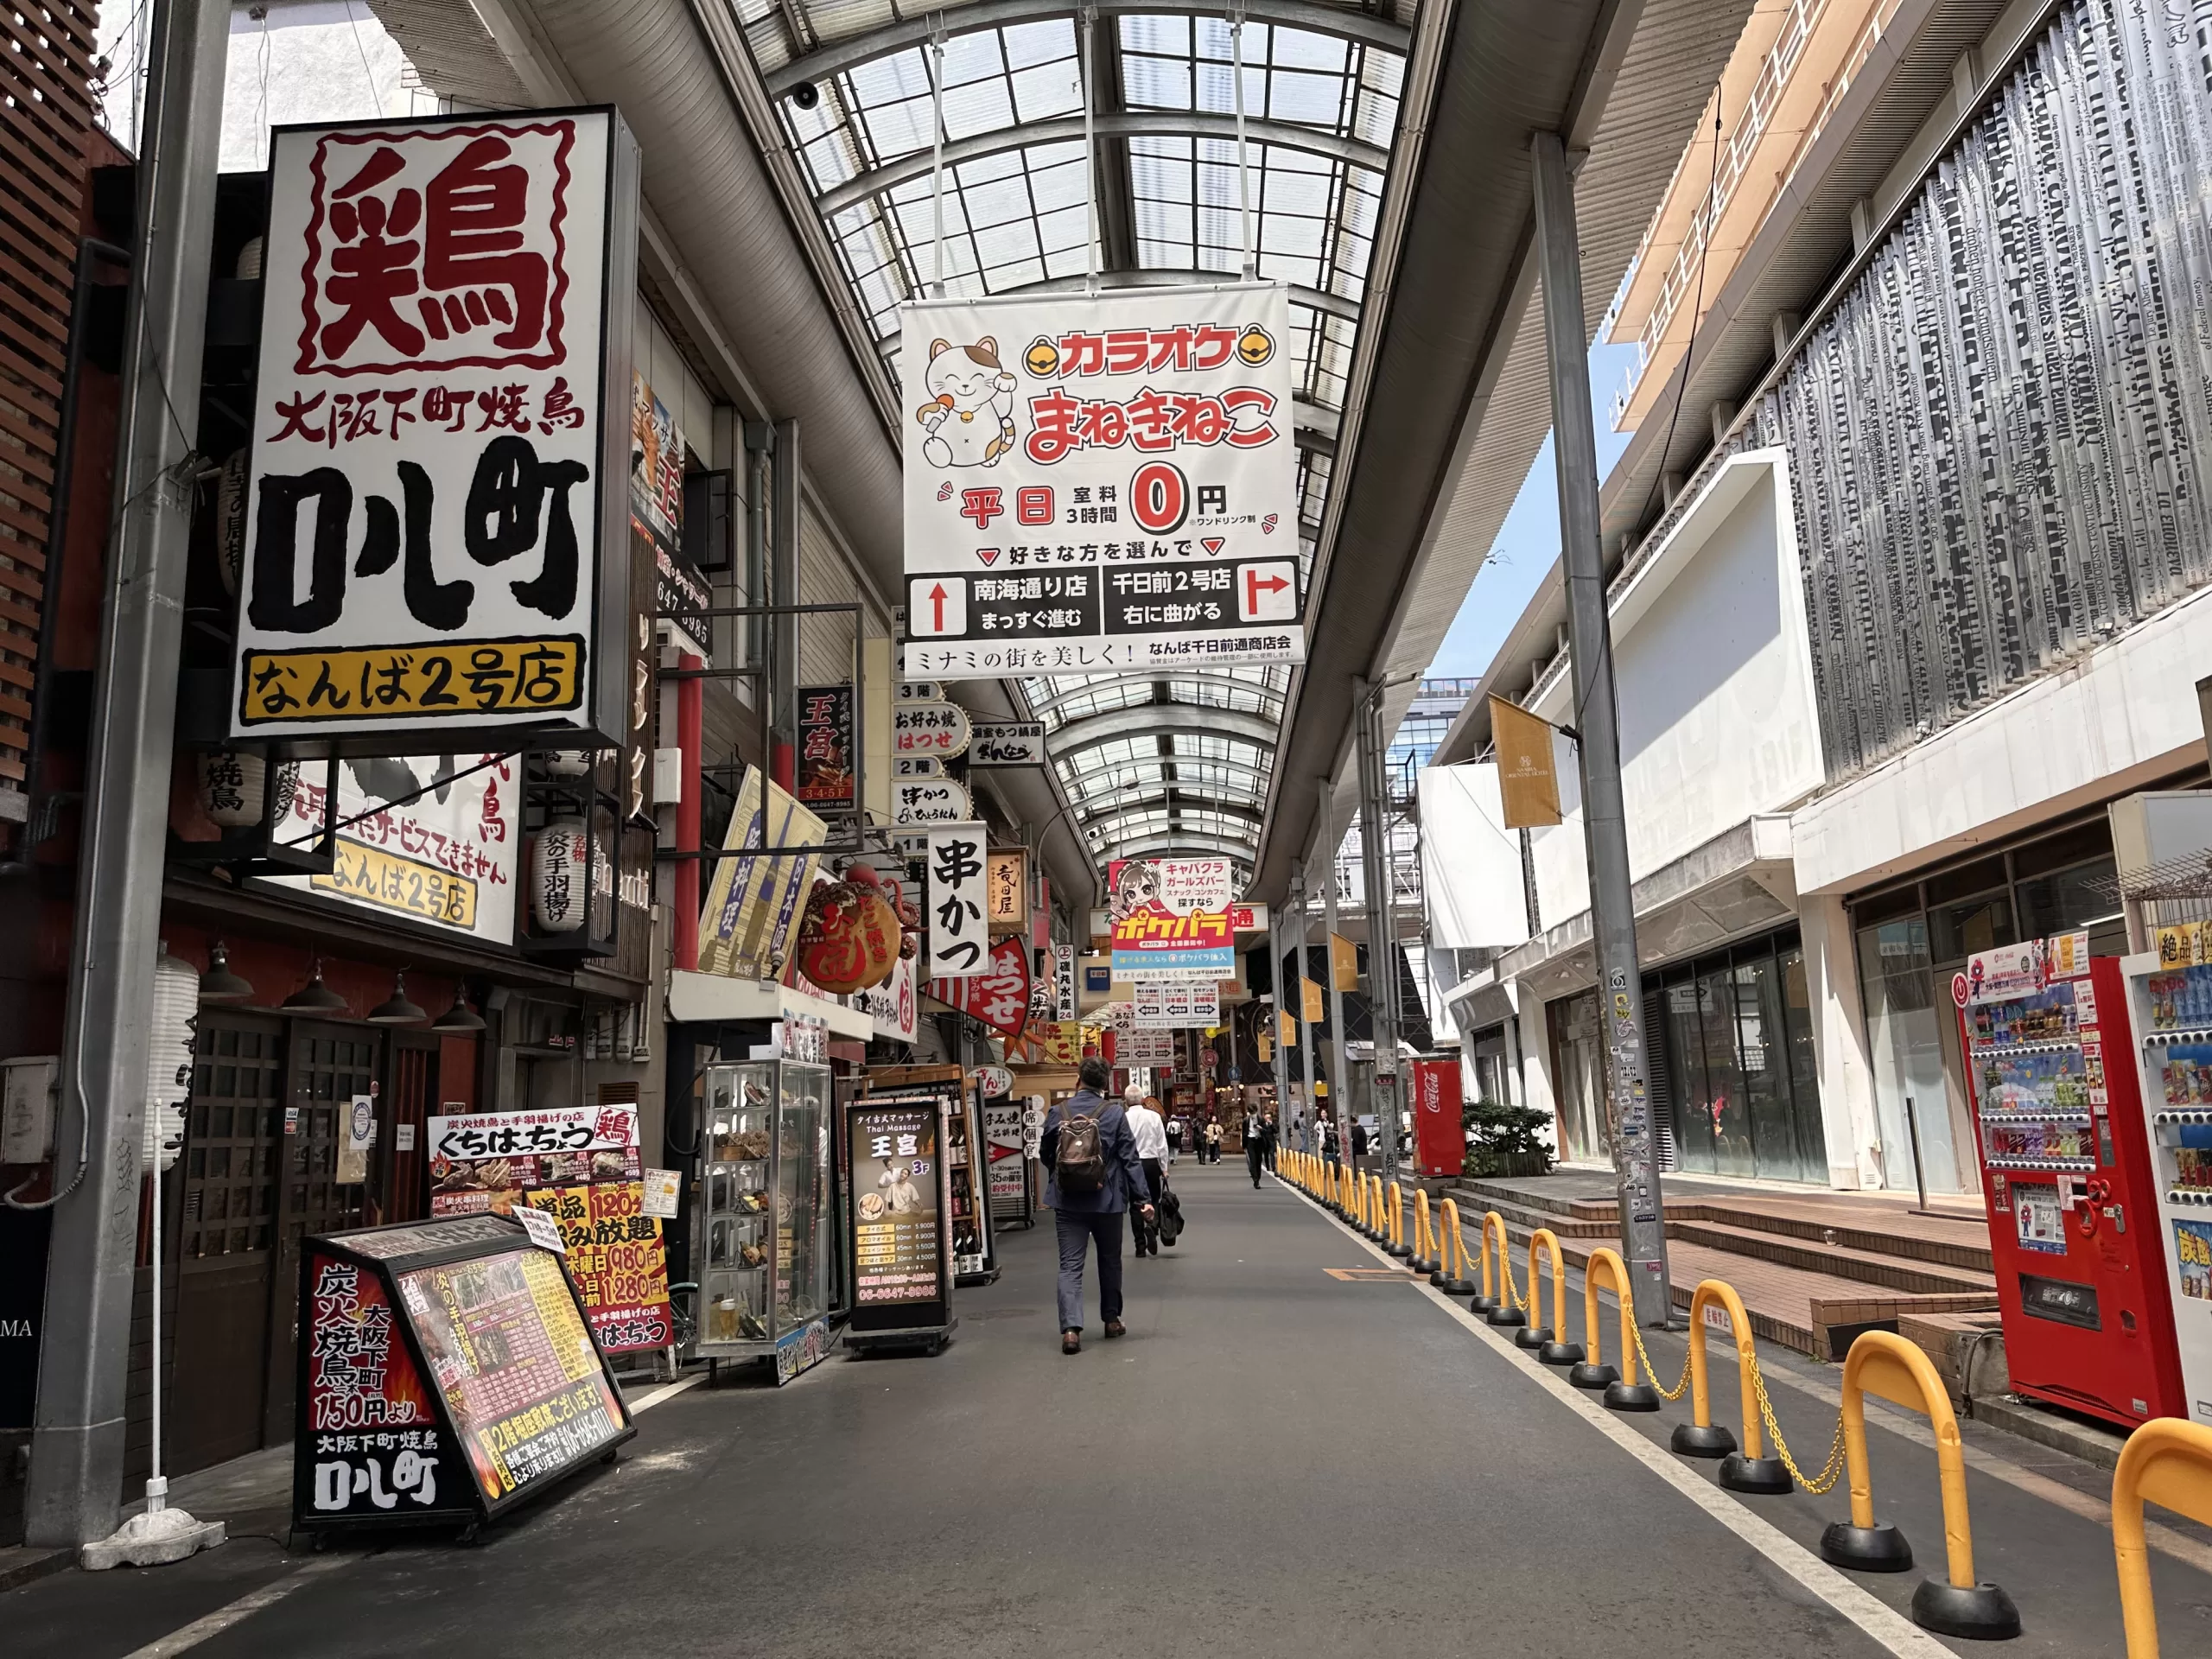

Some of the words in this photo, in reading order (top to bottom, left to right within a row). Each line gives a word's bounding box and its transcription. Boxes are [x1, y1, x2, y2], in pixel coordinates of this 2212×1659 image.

[321, 137, 548, 359] 鶏
[1058, 323, 1239, 379] カラオケ
[266, 378, 584, 448] 大阪下町焼鳥
[1024, 386, 1280, 465] まねきねこ
[961, 485, 1054, 530] 平日
[1073, 485, 1117, 502] 室料
[1066, 507, 1118, 524] 3時間
[1009, 539, 1192, 564] 好きな方を選んで
[974, 575, 1088, 601] 南海通り店
[1112, 568, 1231, 594] 千日前2号店
[982, 608, 1082, 630] まっすぐ進む
[1124, 603, 1222, 625] 右に曲がる
[1149, 635, 1292, 656] なんば千日前通商店会
[255, 644, 564, 709] なんば2号店
[901, 684, 931, 698] 3階
[800, 694, 839, 760] 王宮
[895, 710, 957, 728] お好み焼
[898, 732, 953, 750] はつせ
[900, 760, 930, 774] 2階
[901, 786, 950, 806] 串かつ
[914, 807, 958, 821] ひょうたん
[572, 834, 588, 863] 名物
[903, 837, 929, 850] 1階
[544, 830, 571, 922] 炎の手羽揚げ
[1166, 862, 1224, 874] キャバクラ
[334, 843, 467, 922] なんば2号店
[1166, 876, 1224, 887] ガールズバー
[933, 839, 982, 969] 串かつ
[1178, 898, 1213, 907] 探すなら
[1116, 909, 1228, 939] ポケパラ
[2160, 933, 2191, 963] 絶品
[982, 950, 1026, 1024] はつせ
[1059, 961, 1071, 1010] 磯丸水産
[1426, 1071, 1440, 1113] Coca-Cola
[447, 1112, 584, 1130] 炭火焼鳥と手羽揚げの店
[596, 1109, 631, 1144] 鶏
[857, 1110, 930, 1125] タイ古式マッサージ
[887, 1123, 922, 1132] Massage
[438, 1122, 594, 1158] くちはっちょう
[871, 1134, 918, 1157] 王宮
[912, 1160, 930, 1174] 3F
[535, 1196, 587, 1220] 単品
[612, 1245, 659, 1271] 980円
[603, 1275, 662, 1305] 1280円
[859, 1285, 937, 1300] 06-6647-8985
[0, 1320, 33, 1337] MA
[313, 1263, 360, 1387] 炭火焼鳥
[357, 1303, 391, 1390] 大阪下町
[315, 1393, 416, 1431] 150円より
[317, 1429, 438, 1453] 大阪下町焼鳥
